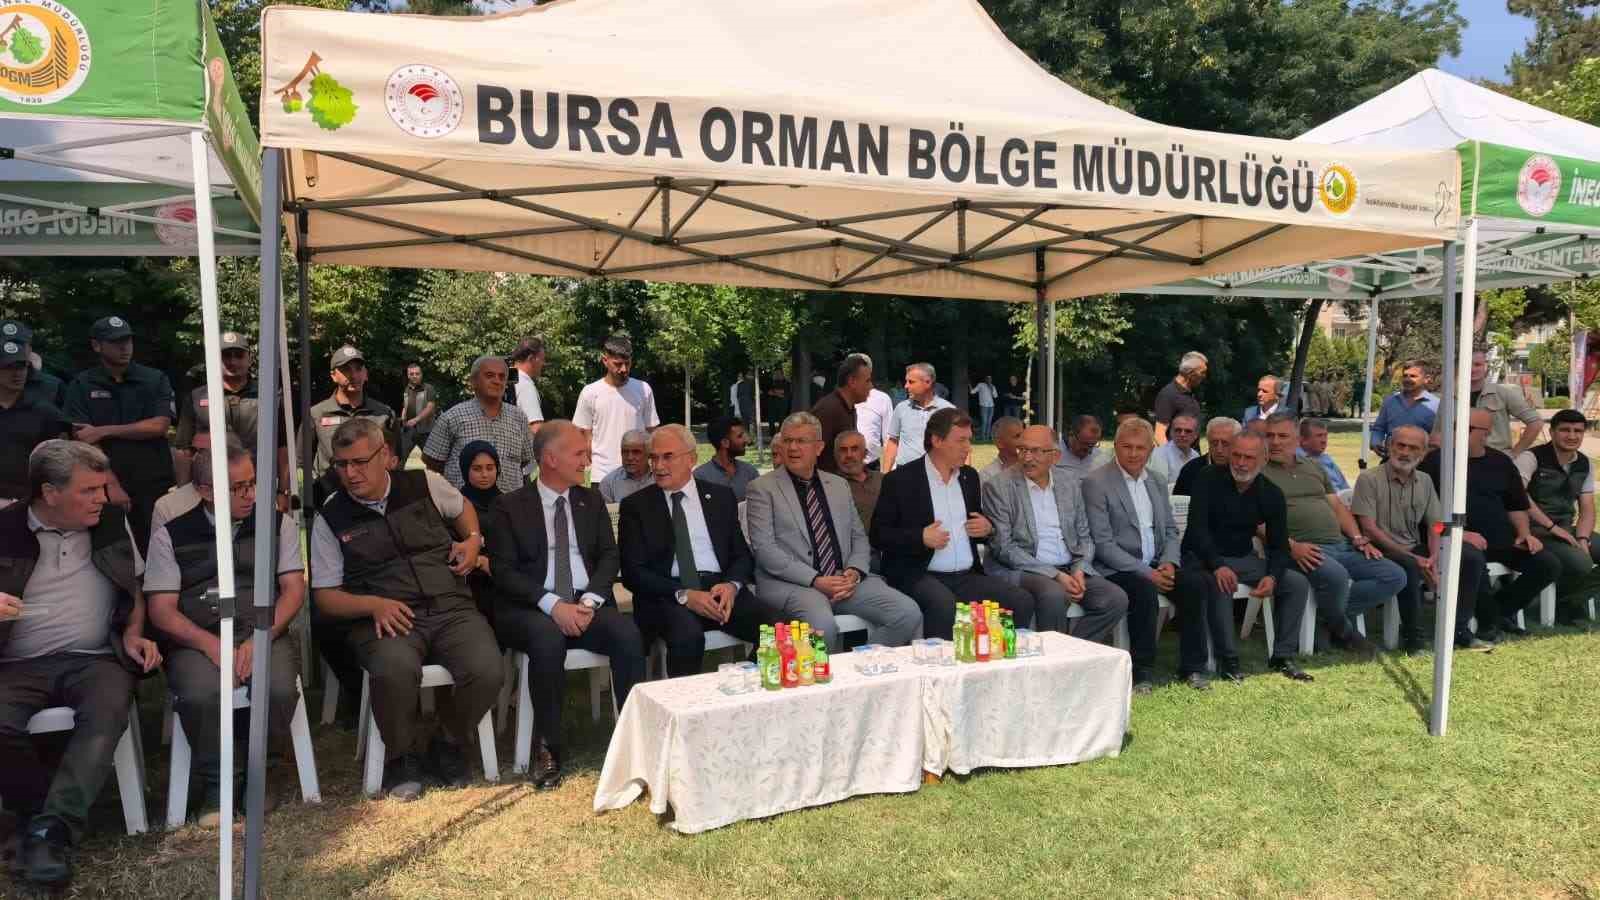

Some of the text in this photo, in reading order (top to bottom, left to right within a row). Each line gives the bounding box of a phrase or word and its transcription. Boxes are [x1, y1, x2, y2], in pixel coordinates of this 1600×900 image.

[0, 66, 31, 87] OGM
[477, 84, 683, 158] BURSA
[700, 106, 889, 176] ORMAN
[907, 121, 1057, 189] BÖLGE
[1073, 137, 1314, 213] MÜDÜRLÜĞÜ
